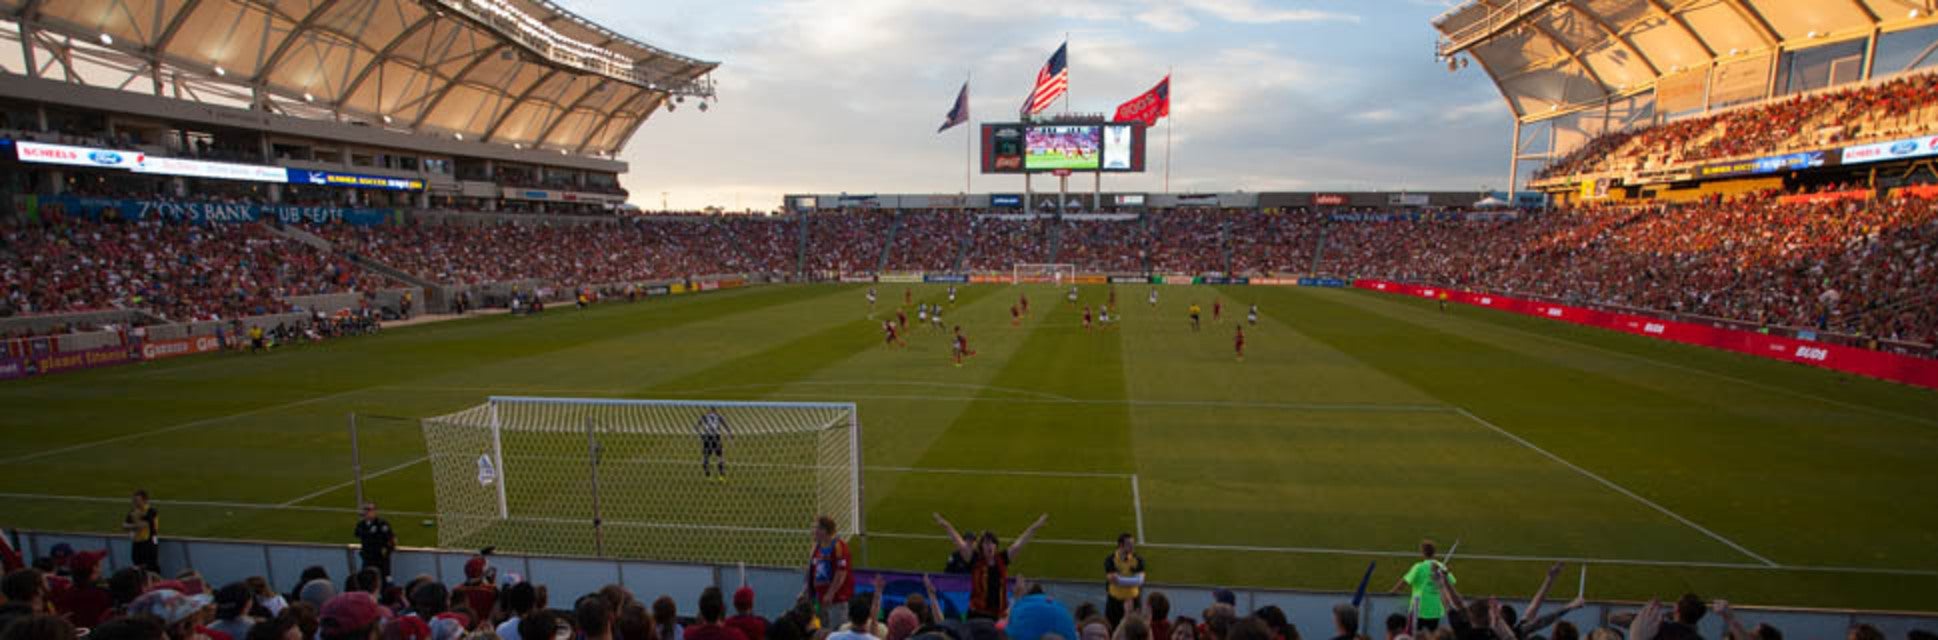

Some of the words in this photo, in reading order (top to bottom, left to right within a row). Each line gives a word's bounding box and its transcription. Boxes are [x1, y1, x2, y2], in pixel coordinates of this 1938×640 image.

[23, 147, 78, 160] SCHEELS
[136, 201, 200, 220] ZONS
[204, 203, 254, 221] BANK
[1795, 345, 1828, 361] BUDS
[39, 353, 83, 373] planet
